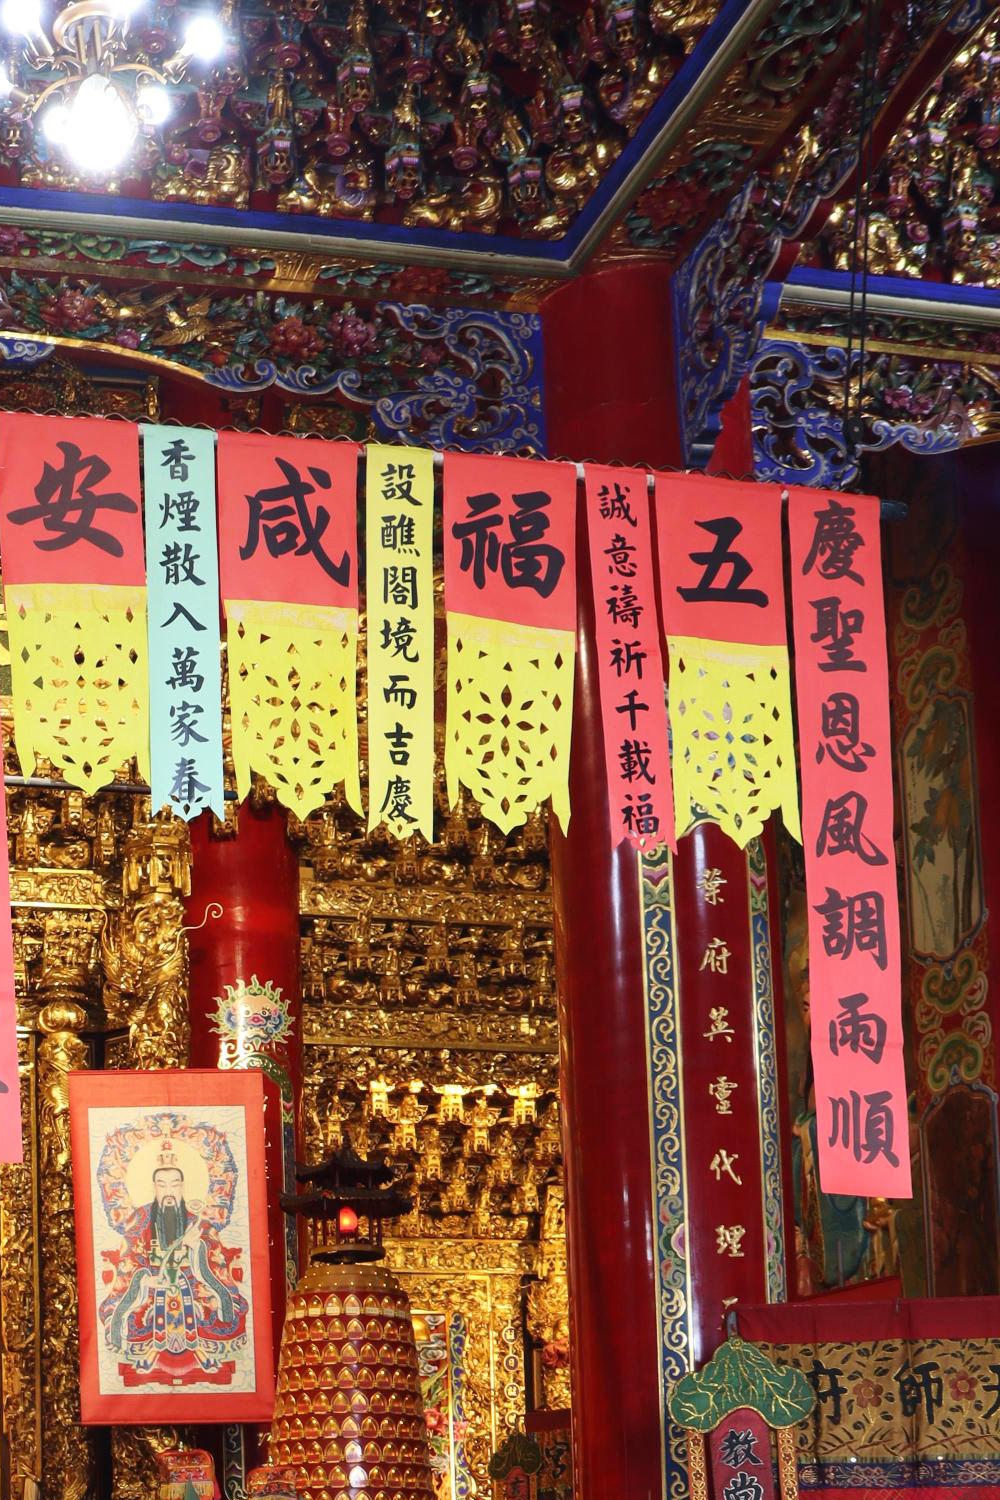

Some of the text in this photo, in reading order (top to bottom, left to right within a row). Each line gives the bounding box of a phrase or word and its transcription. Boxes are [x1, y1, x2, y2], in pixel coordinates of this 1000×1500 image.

[6, 440, 770, 608] 五 福 咸 安
[159, 438, 212, 802] 香煙散入萬家春
[379, 463, 423, 823] 設醮閤境而吉慶
[597, 482, 660, 835] 誠意禱祈千載福
[801, 498, 901, 1169] 慶聖恩風調雨順
[696, 868, 747, 1330] 葉府英靈代理
